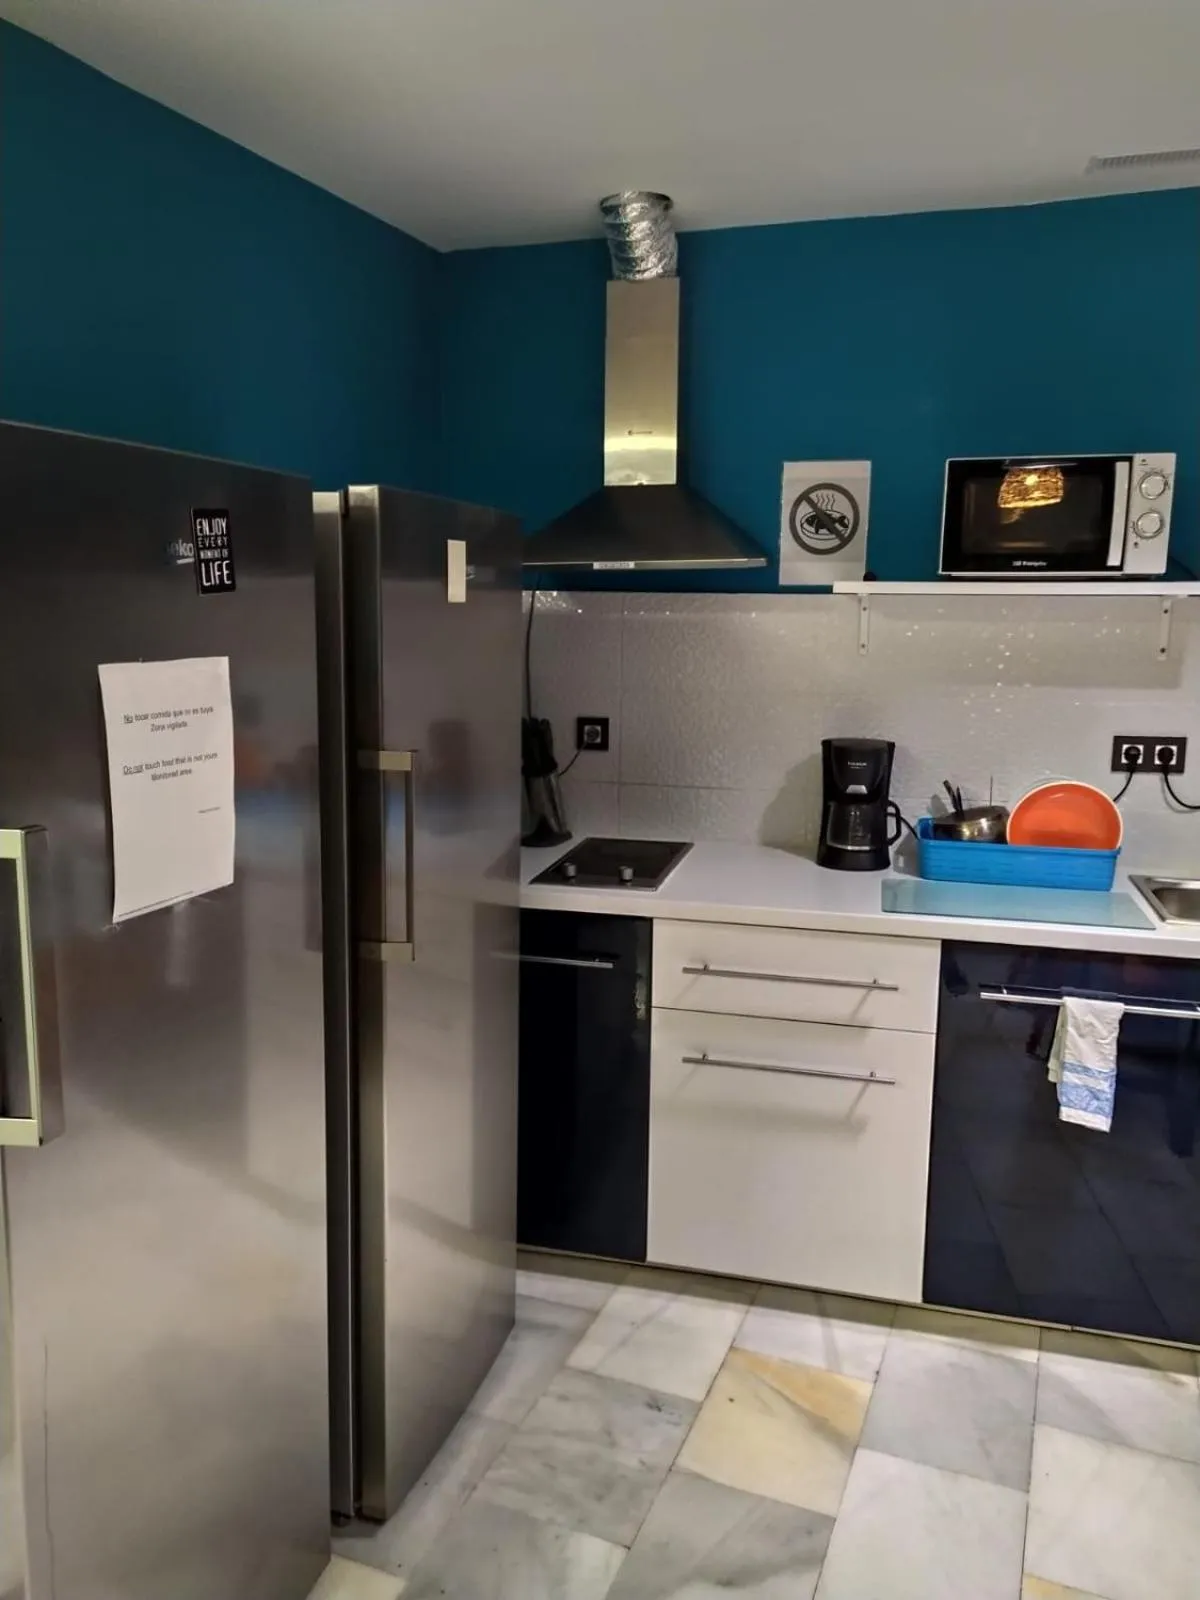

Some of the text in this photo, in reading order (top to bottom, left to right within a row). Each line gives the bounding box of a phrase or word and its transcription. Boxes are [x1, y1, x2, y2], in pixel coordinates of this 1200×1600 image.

[196, 517, 227, 536] ENJOY
[198, 536, 228, 548] EVERY
[201, 560, 232, 586] LIFE
[150, 711, 171, 719] comida
[172, 710, 183, 718] que
[144, 761, 161, 770] touch
[174, 758, 186, 766] that
[193, 755, 203, 763] not
